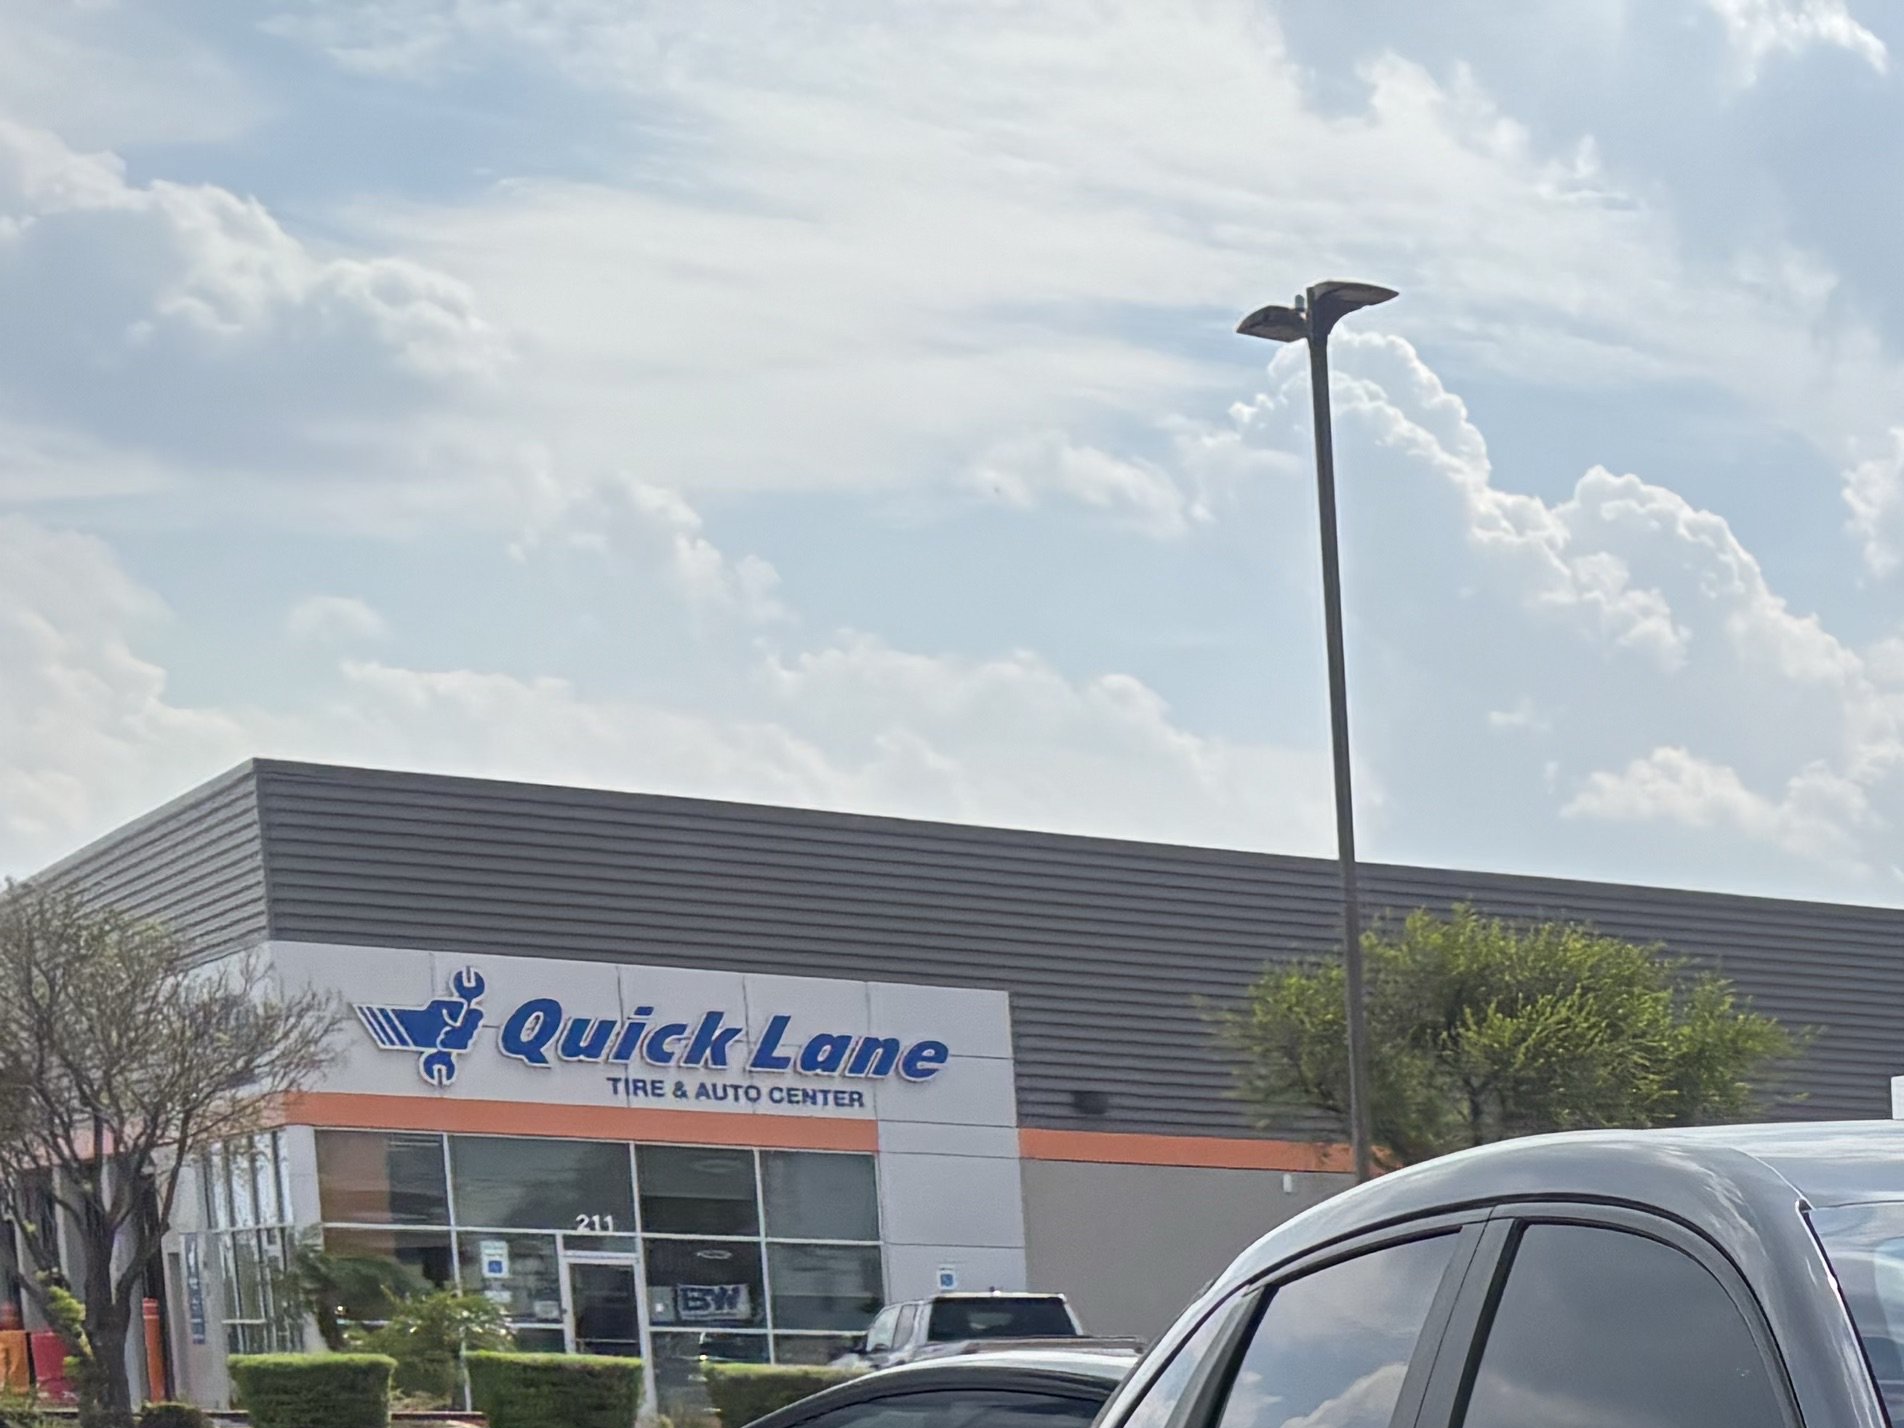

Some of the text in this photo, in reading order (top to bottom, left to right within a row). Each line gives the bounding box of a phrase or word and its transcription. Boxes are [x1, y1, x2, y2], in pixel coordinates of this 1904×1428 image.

[498, 996, 951, 1081] Quick Lane
[606, 1077, 866, 1108] TIRE & AUTO CENTER
[574, 1213, 614, 1232] 211
